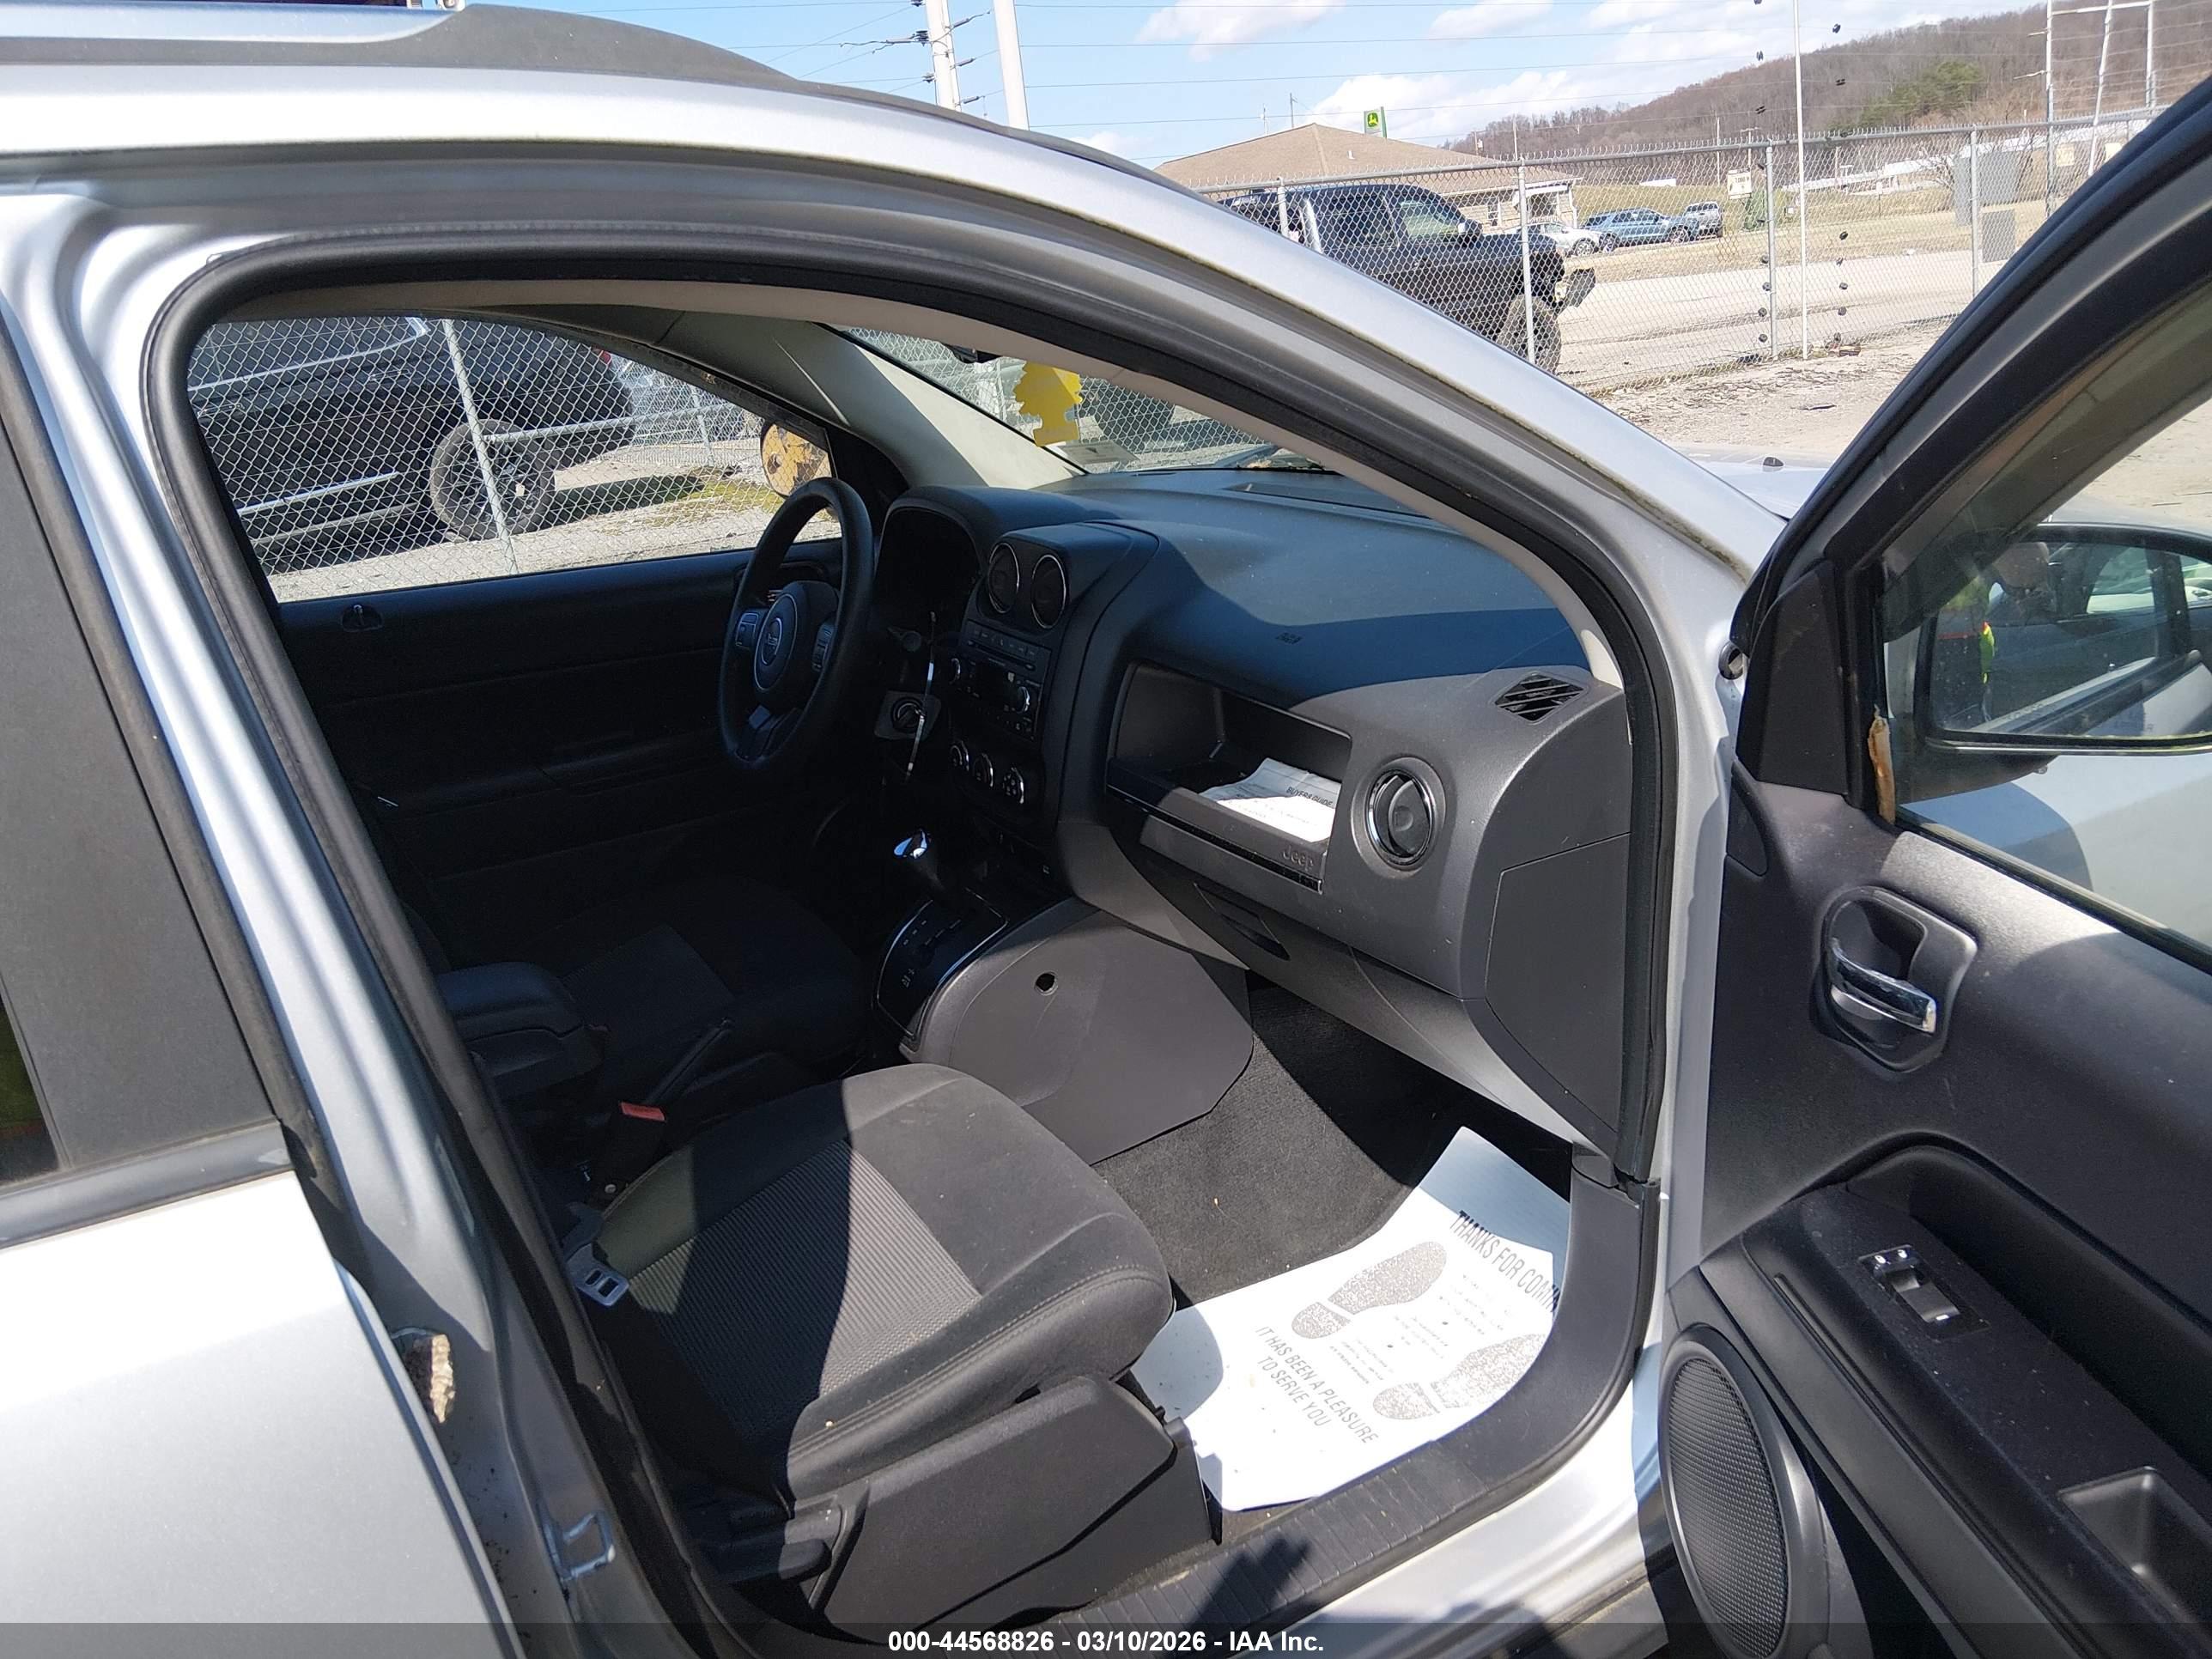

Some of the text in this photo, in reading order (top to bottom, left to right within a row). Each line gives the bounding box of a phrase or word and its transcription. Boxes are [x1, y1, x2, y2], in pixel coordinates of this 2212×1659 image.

[1312, 795, 1333, 807] GUIDE
[1283, 845, 1314, 872] Jeep
[1449, 1210, 1500, 1259] THANKS
[1492, 1247, 1525, 1279] FOR
[1255, 1327, 1275, 1336] IT
[1265, 1336, 1292, 1356] HAS
[1285, 1354, 1318, 1381] BEEN
[1309, 1381, 1325, 1390] A
[1318, 1389, 1379, 1443] PLEASURE
[1257, 1356, 1332, 1426] TO SERVE YOU
